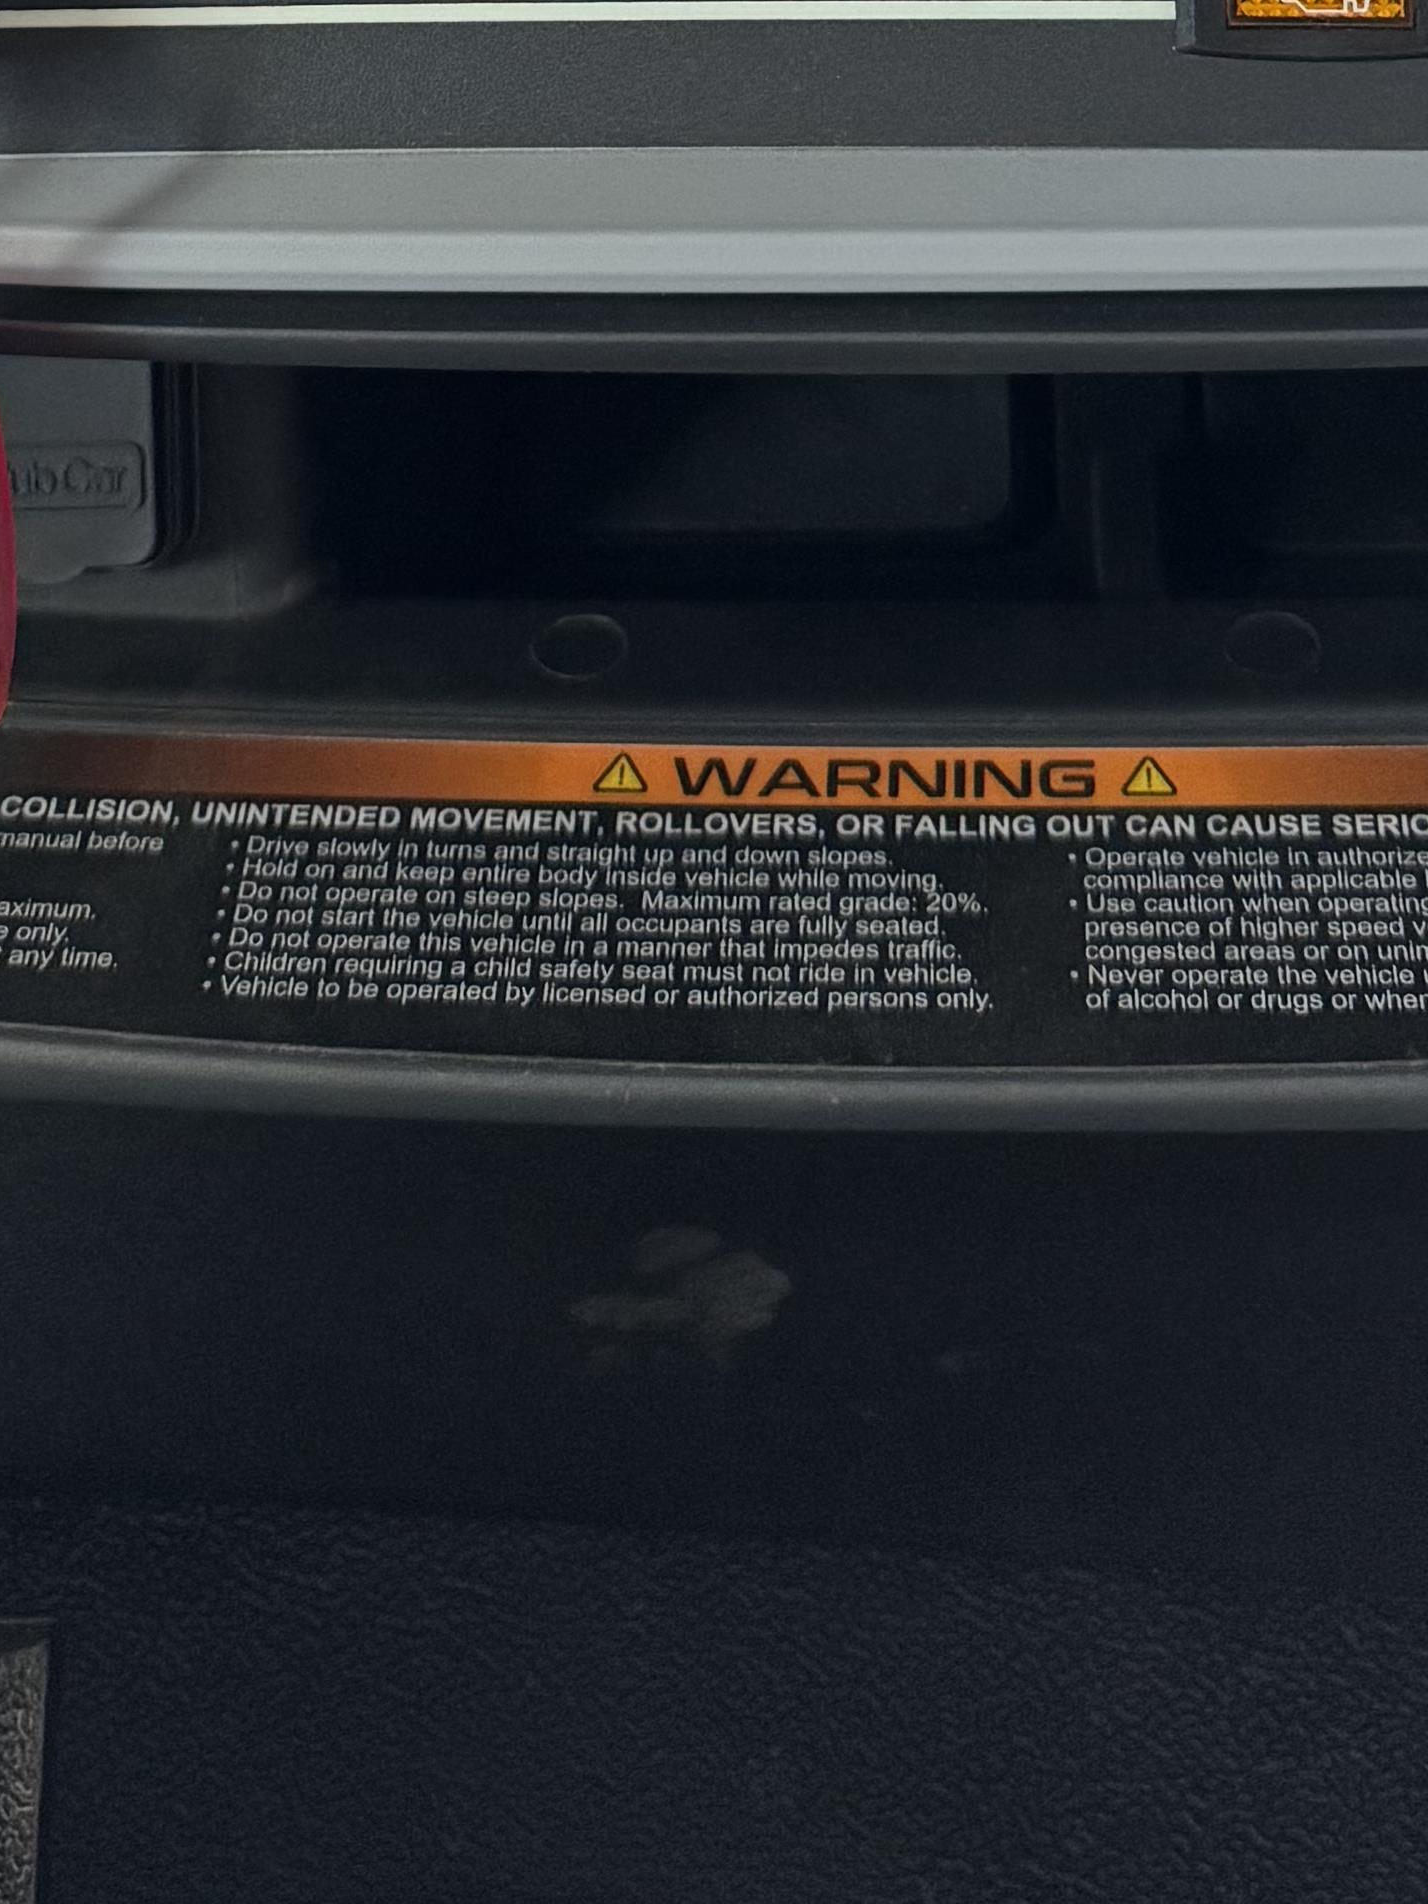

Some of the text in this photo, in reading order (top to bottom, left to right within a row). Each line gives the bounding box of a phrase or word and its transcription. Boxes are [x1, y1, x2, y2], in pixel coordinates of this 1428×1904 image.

[671, 755, 1097, 798] WARNING
[0, 794, 179, 829] COLLISION,
[191, 801, 400, 830] UNINTENDED
[410, 806, 603, 838] MOVEMENT,
[615, 809, 824, 841] ROLLOVERS,
[836, 812, 884, 836] OR
[895, 813, 1035, 837] FALLING
[1046, 813, 1114, 837] OUT
[1125, 813, 1195, 837] CAN
[1206, 813, 1321, 837] CAUSE
[86, 831, 164, 854] before
[246, 836, 892, 873] Drive slowly in turns and straight up and down slopes.
[1085, 846, 1184, 872] Operate
[1192, 846, 1279, 866] vehicle
[1287, 846, 1309, 866] in
[242, 859, 943, 895] Hold on and keep entire body inside vehicle while moving.
[1083, 870, 1224, 895] compliance
[1231, 870, 1282, 890] with
[1290, 870, 1416, 895] applicable
[1086, 894, 1135, 914] Use
[1143, 894, 1234, 914] caution
[1241, 894, 1309, 914] when
